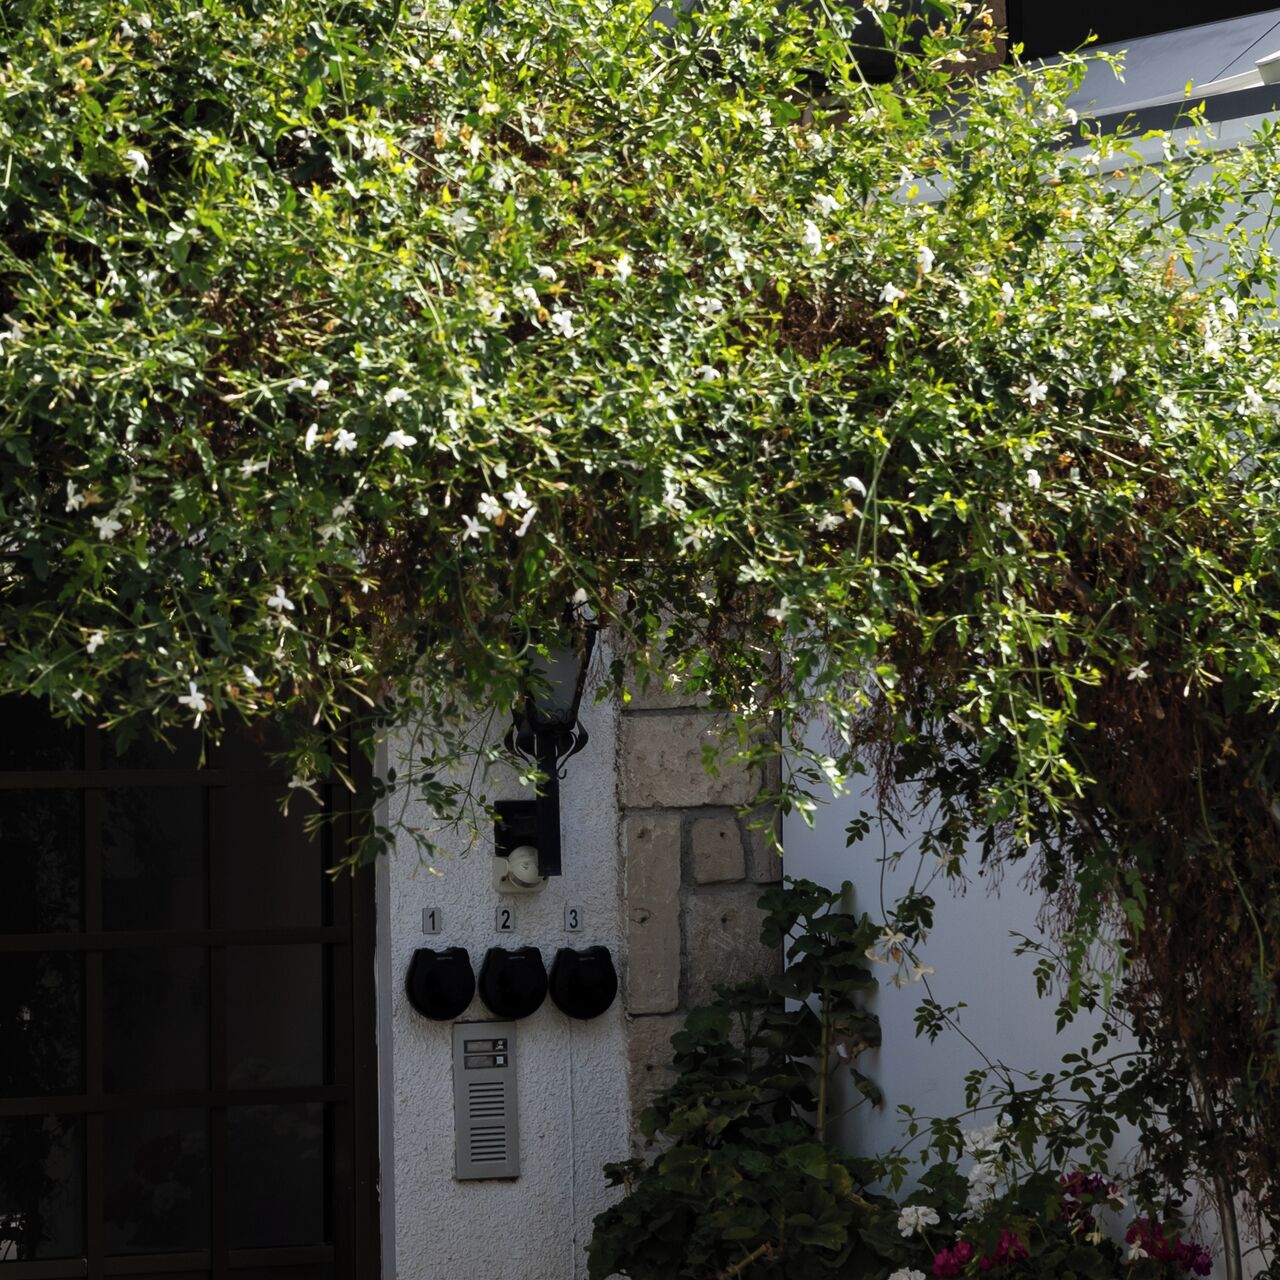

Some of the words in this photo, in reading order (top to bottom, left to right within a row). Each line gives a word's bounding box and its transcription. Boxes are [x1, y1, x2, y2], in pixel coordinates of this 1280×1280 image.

[428, 910, 436, 931] 1
[501, 909, 511, 930] 2
[569, 908, 578, 929] 3
